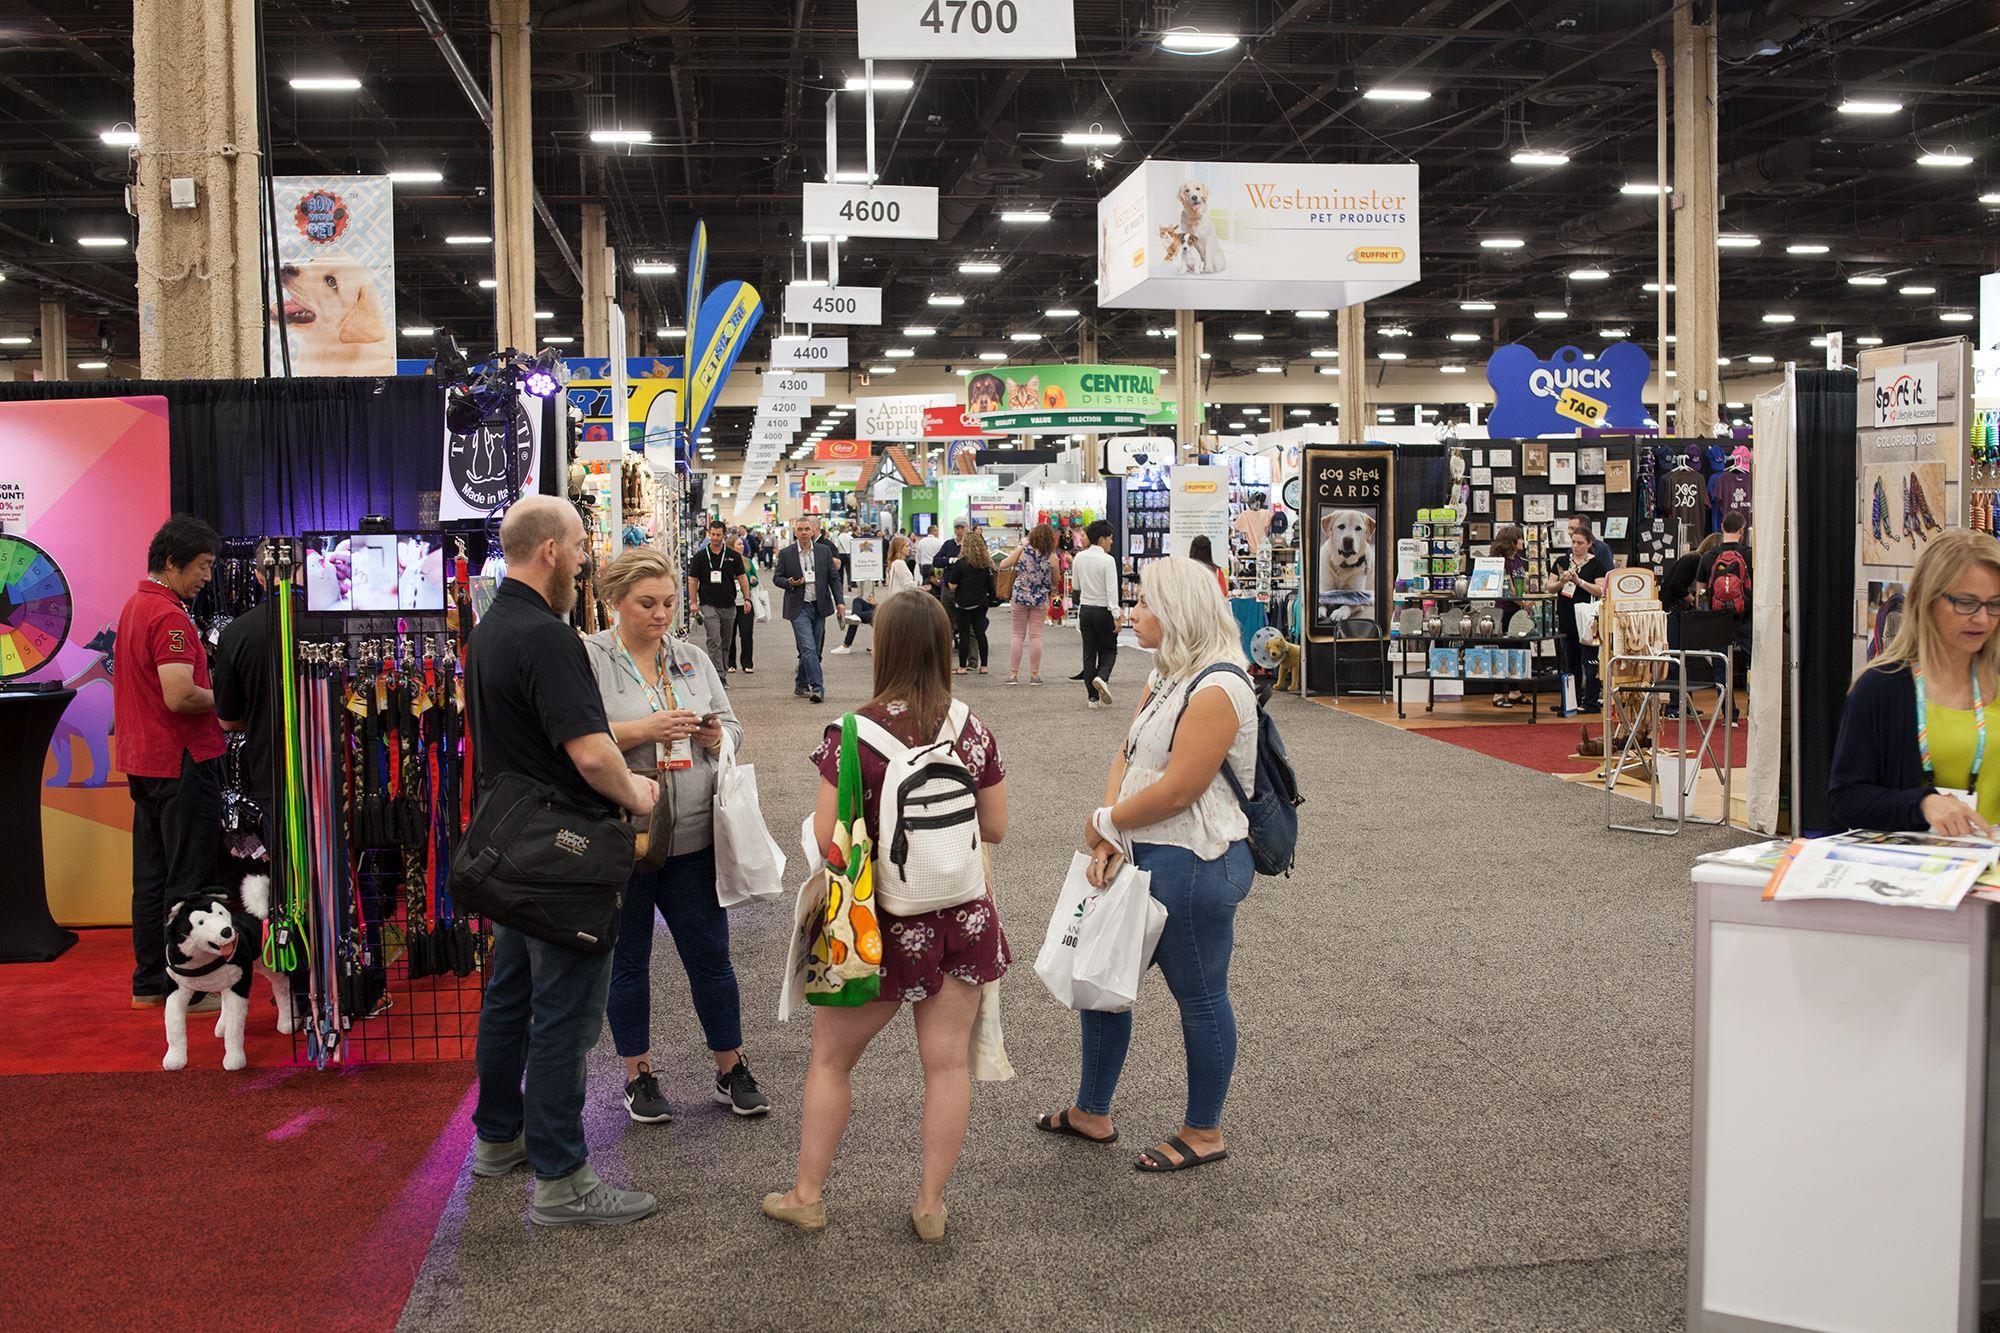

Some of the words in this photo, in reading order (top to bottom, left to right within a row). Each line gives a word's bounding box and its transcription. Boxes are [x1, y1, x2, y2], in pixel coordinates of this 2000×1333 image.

[920, 0, 1019, 34] 4700
[1245, 184, 1406, 210] Westminster
[839, 200, 901, 223] 4600
[1310, 213, 1332, 223] PET
[1340, 213, 1406, 223] PRODUCTS
[306, 222, 335, 240] PET
[1392, 251, 1399, 259] IT
[812, 298, 857, 314] 4500
[700, 299, 747, 390] PETSPORT
[793, 346, 829, 361] 4400
[779, 380, 808, 391] 4300
[1080, 373, 1155, 395] CENTRAL
[1529, 368, 1612, 398] QUICK
[772, 403, 797, 413] 4200
[1569, 397, 1599, 420] TAG
[767, 420, 789, 428] 4100
[866, 415, 918, 436] Supply
[1030, 416, 1052, 424] VALUE
[1067, 415, 1102, 424] SELECTION
[1876, 435, 1918, 450] COLORADO,
[1920, 432, 1937, 447] USA
[1319, 468, 1344, 482] dog
[461, 482, 486, 505] Made
[487, 492, 497, 504] in
[911, 489, 934, 500] DOG
[1319, 484, 1381, 497] CARDS
[17, 557, 26, 566] 5
[169, 630, 185, 652] 3
